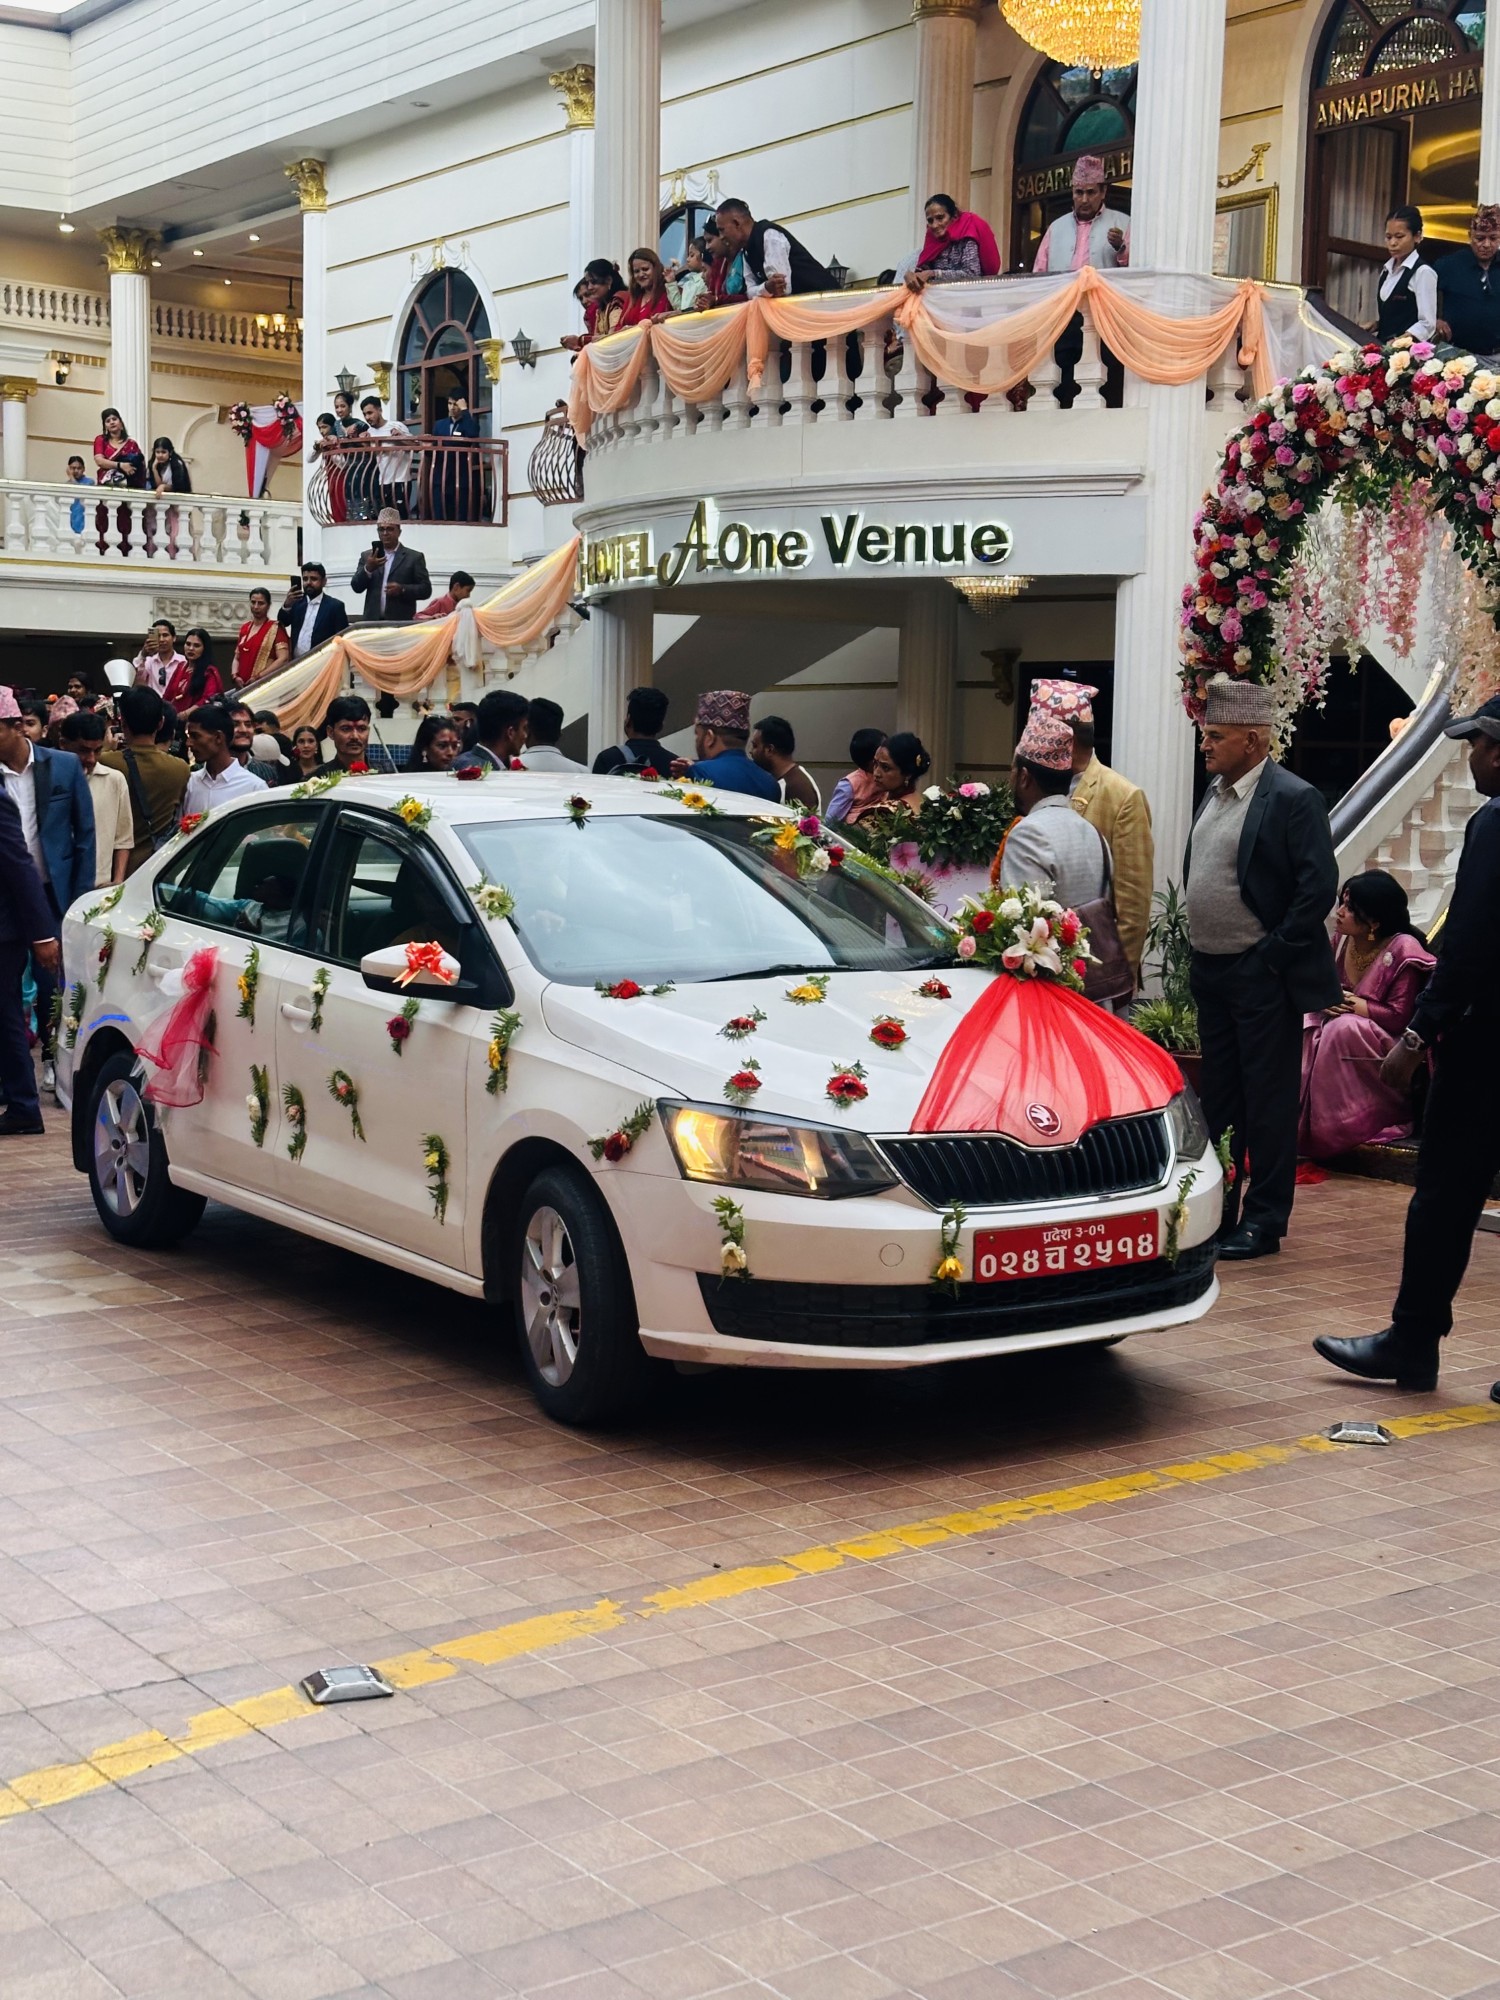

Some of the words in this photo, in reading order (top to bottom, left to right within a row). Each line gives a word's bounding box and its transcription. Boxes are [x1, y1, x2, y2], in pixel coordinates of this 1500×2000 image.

[1314, 78, 1440, 129] ANNAPURNA
[1448, 66, 1484, 100] HA
[574, 530, 659, 594] HOTEL
[820, 513, 1011, 566] Venue
[155, 598, 202, 620] REST
[208, 600, 252, 621] ROO
[1042, 1227, 1072, 1244] प्रदेश
